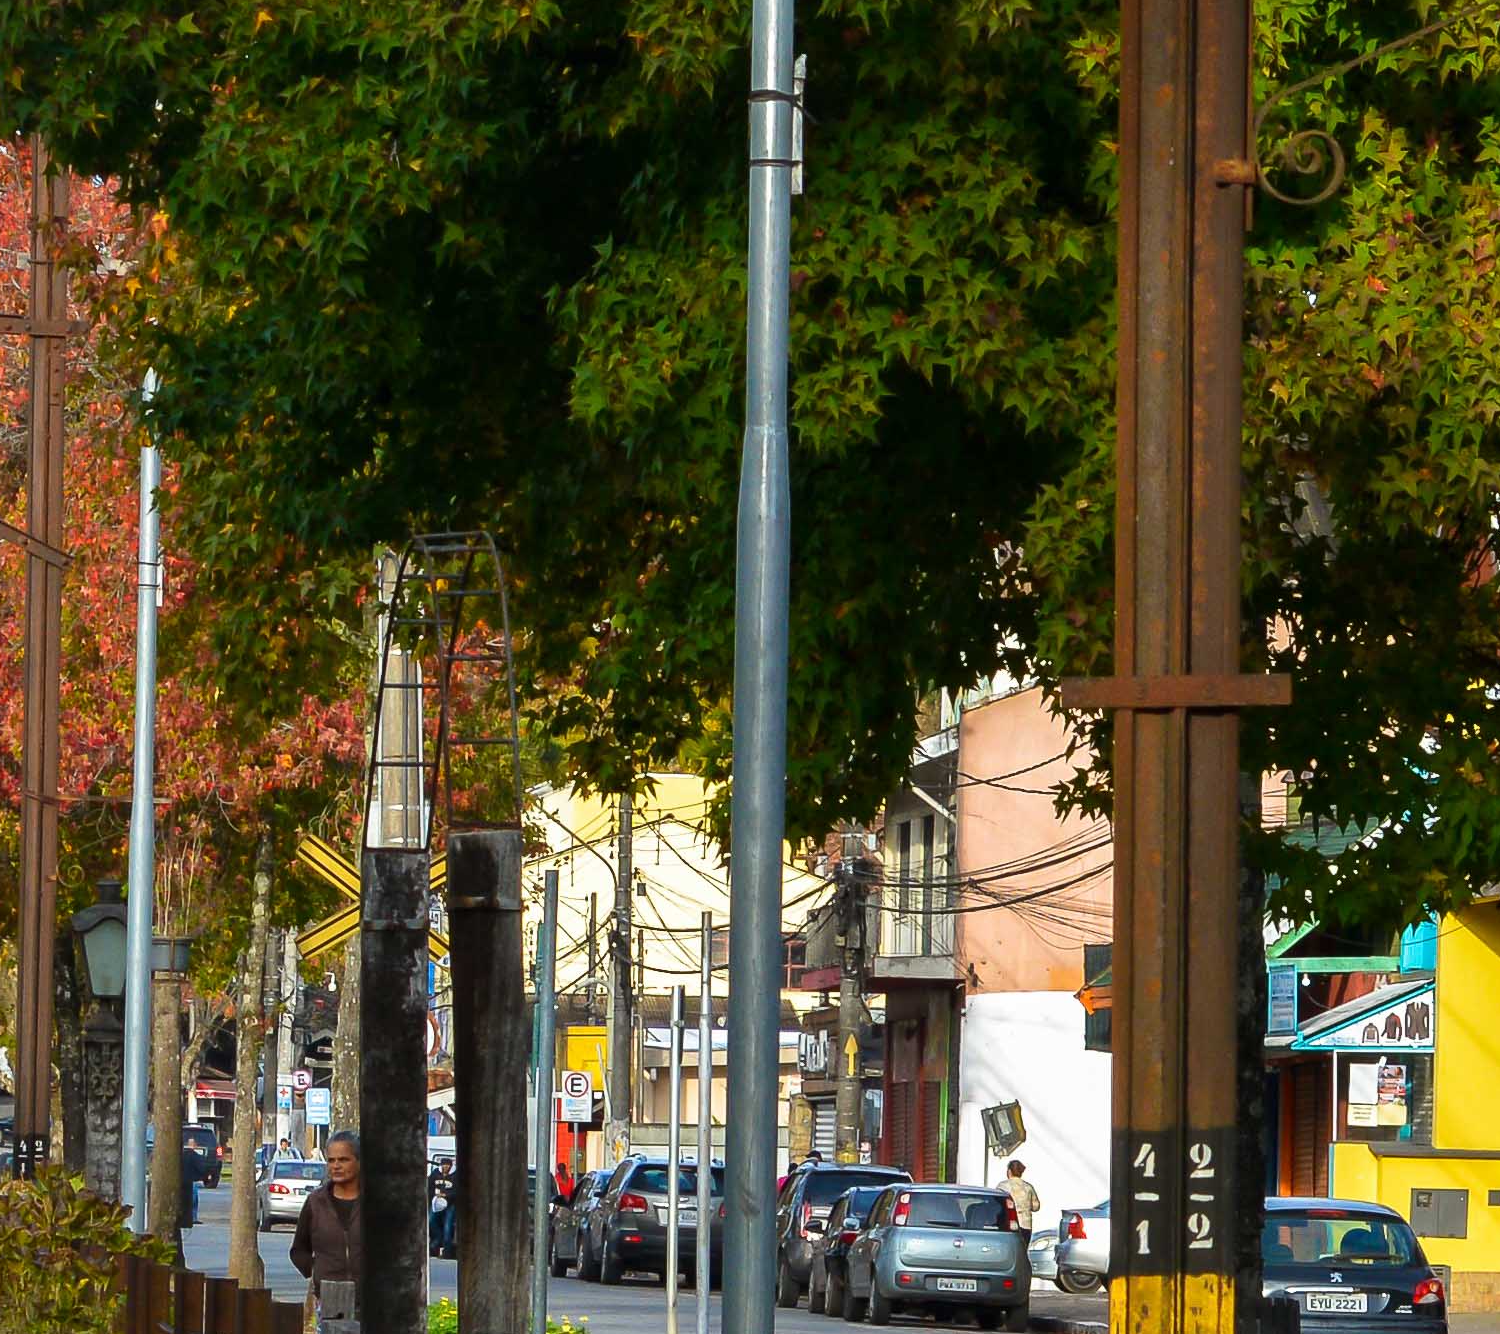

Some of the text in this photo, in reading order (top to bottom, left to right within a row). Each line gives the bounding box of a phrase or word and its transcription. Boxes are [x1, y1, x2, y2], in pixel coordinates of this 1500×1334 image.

[570, 1077, 584, 1093] E
[1310, 1298, 1362, 1310] EYU 2221
